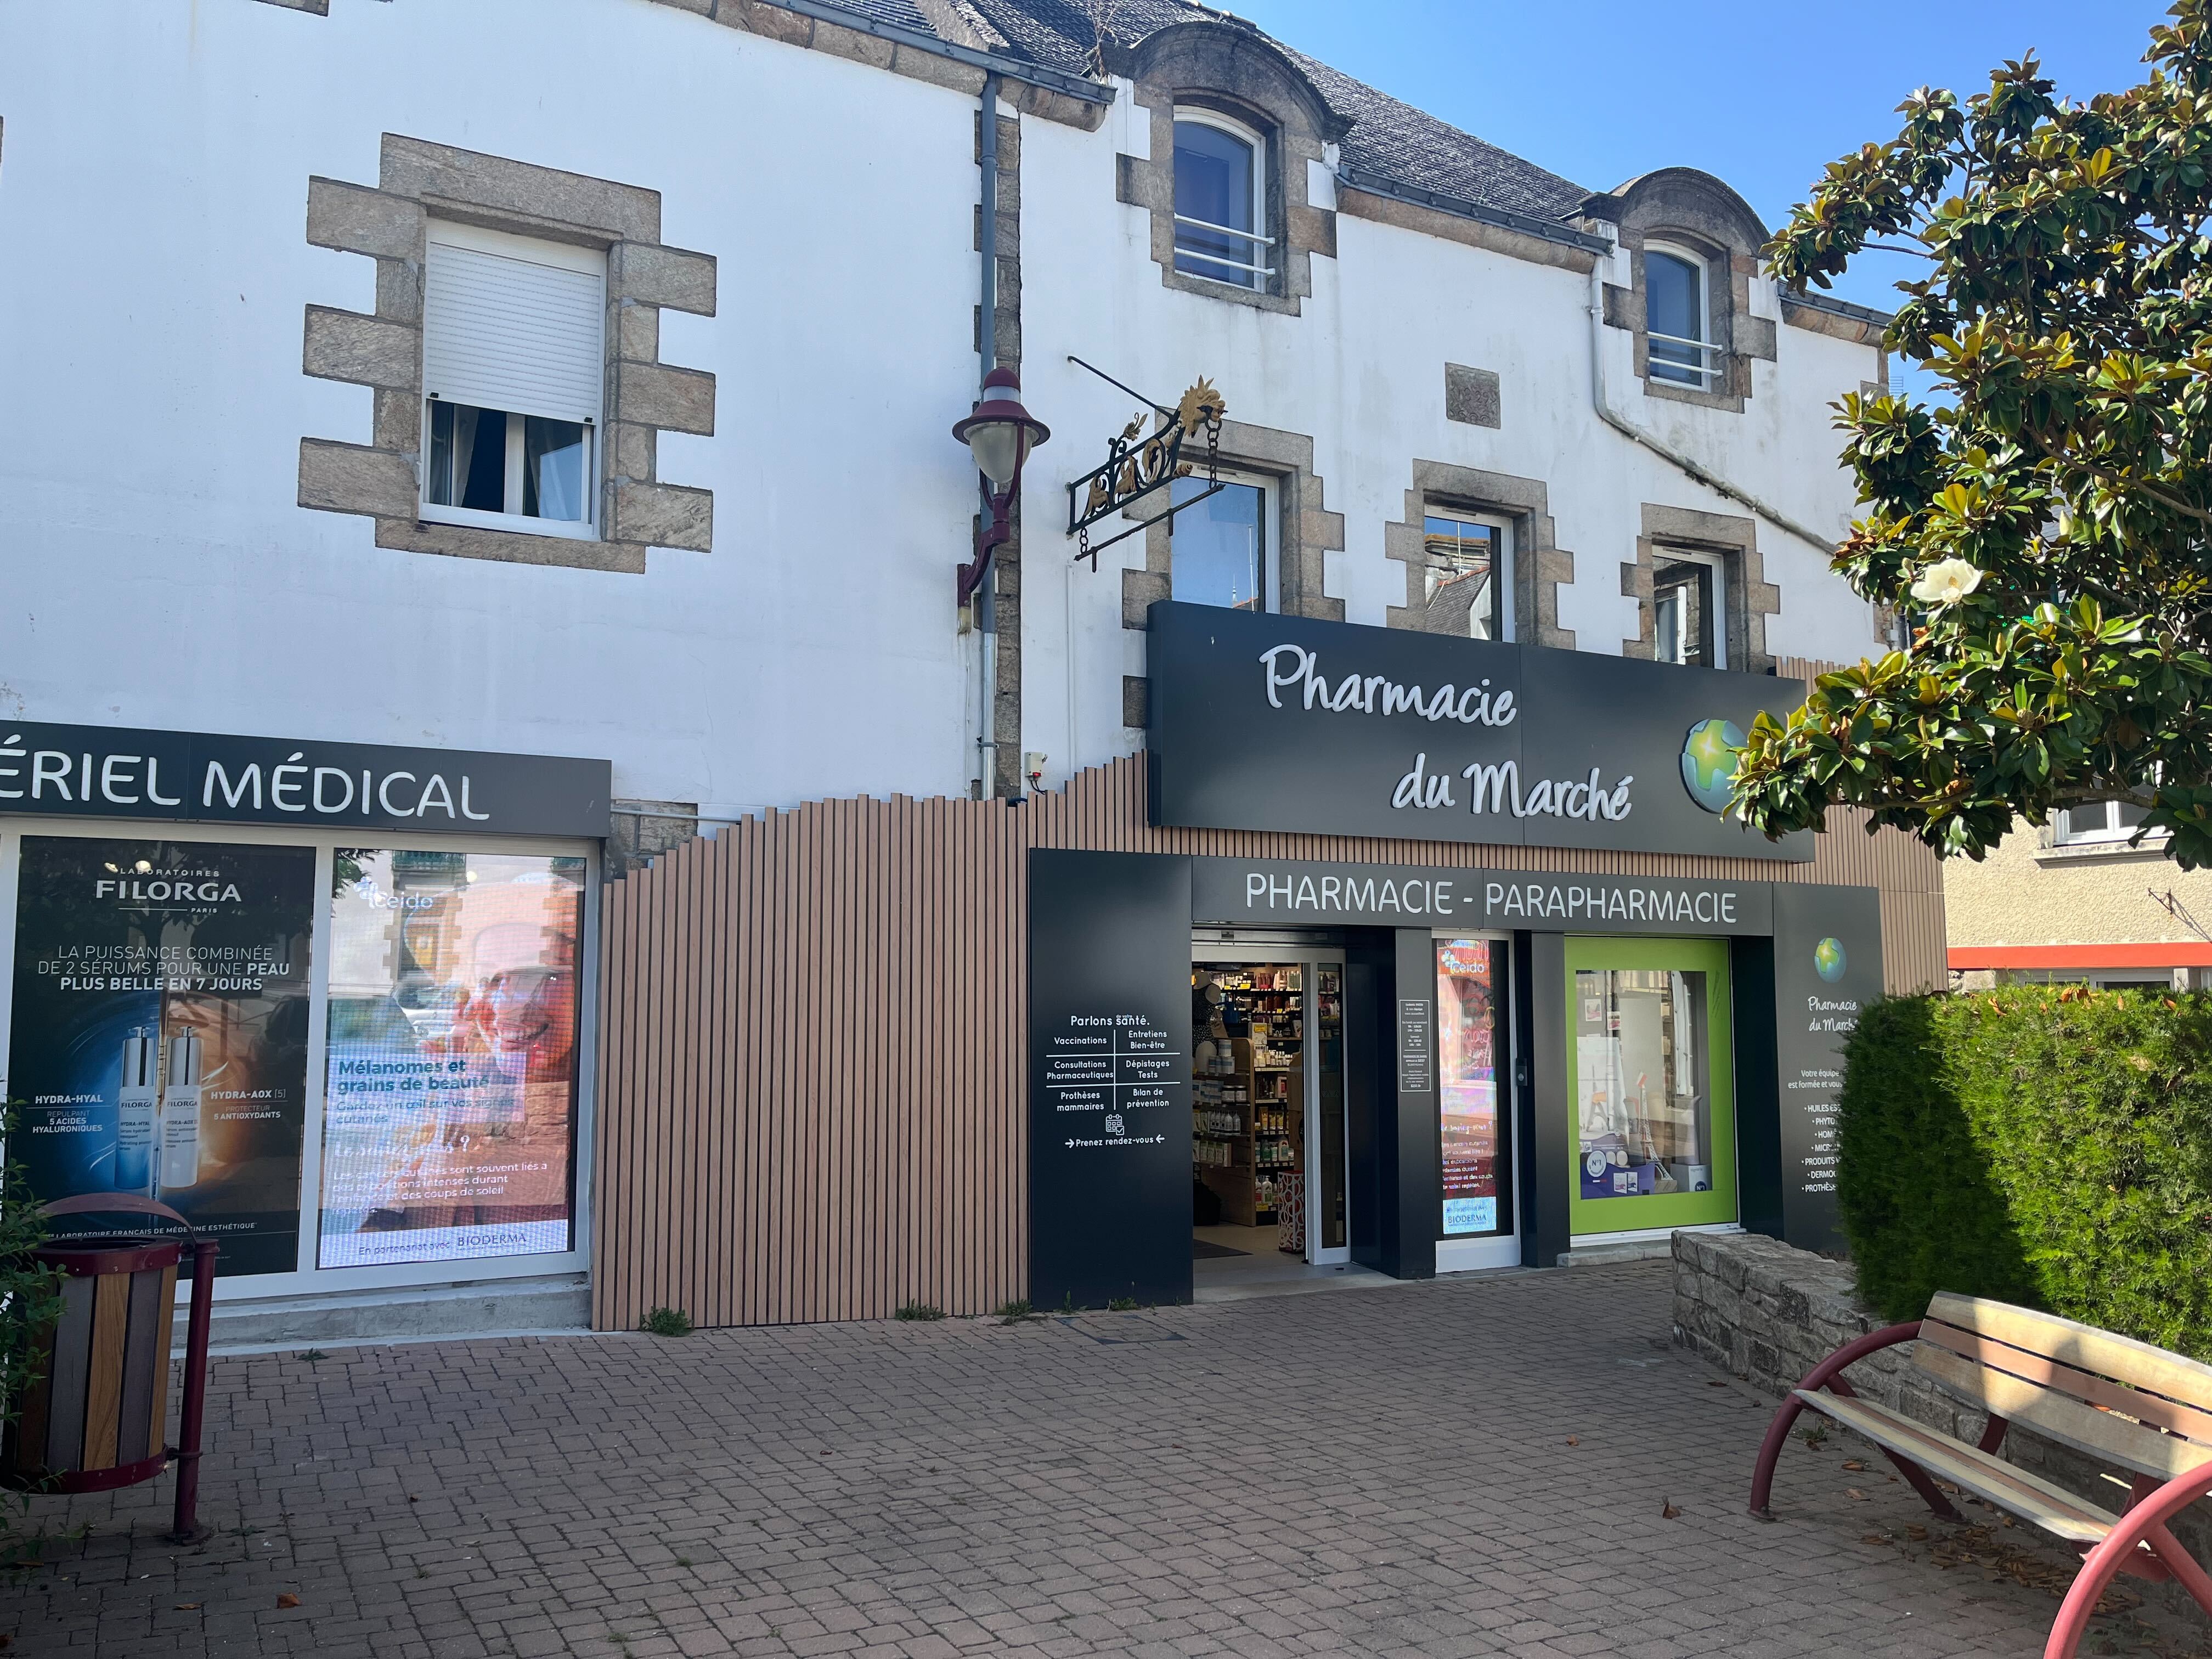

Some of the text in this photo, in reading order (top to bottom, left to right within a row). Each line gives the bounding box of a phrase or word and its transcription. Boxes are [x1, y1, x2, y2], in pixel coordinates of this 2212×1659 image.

[1259, 644, 1517, 727] Pharmacie
[202, 752, 490, 821] MÉDICAL
[1391, 753, 1634, 822] du Marché
[120, 868, 220, 877] LABORATOIRES
[95, 880, 242, 902] FILORGA
[1246, 872, 1454, 915] PHARMACIE
[1486, 882, 1737, 924] PARAPHARMACIE
[59, 944, 273, 960] LA PUISSANCE COMBINÉE
[38, 958, 289, 975] DE 2 SÉRUMS POUR UNE PEAU
[60, 977, 262, 990] PLUS BELLE EN 7 JOURS
[1807, 996, 1858, 1011] Pharmacie
[1070, 1014, 1150, 1026] Parlons santé.
[1809, 1018, 1822, 1031] du
[1128, 1030, 1167, 1038] Entretiens
[338, 1059, 466, 1075] Mélanomes et
[1126, 1060, 1170, 1069] Dépistages
[1046, 1071, 1114, 1080] Pharmaceutiques
[337, 1075, 489, 1094] grains de beauté
[1798, 1080, 1820, 1088] formée
[35, 1094, 104, 1104] HYDRA-HYAL
[211, 1090, 272, 1099] HYDRA-AOX
[1057, 1103, 1105, 1111] mammaires
[1126, 1099, 1170, 1109] prévention
[1807, 1104, 1830, 1113] HUILES
[220, 1111, 281, 1120] ANTIOXYDANTS
[56, 1117, 87, 1125] ACIDES
[32, 1124, 103, 1133] HYALURONIQUES
[1075, 1137, 1154, 1147] Prenez rendez-vous
[1805, 1157, 1835, 1166] PRODUITS
[476, 1164, 519, 1173] souvent
[472, 1175, 509, 1184] durant
[166, 1224, 207, 1234] MÉDEINE
[457, 1233, 527, 1246] BIODERMA
